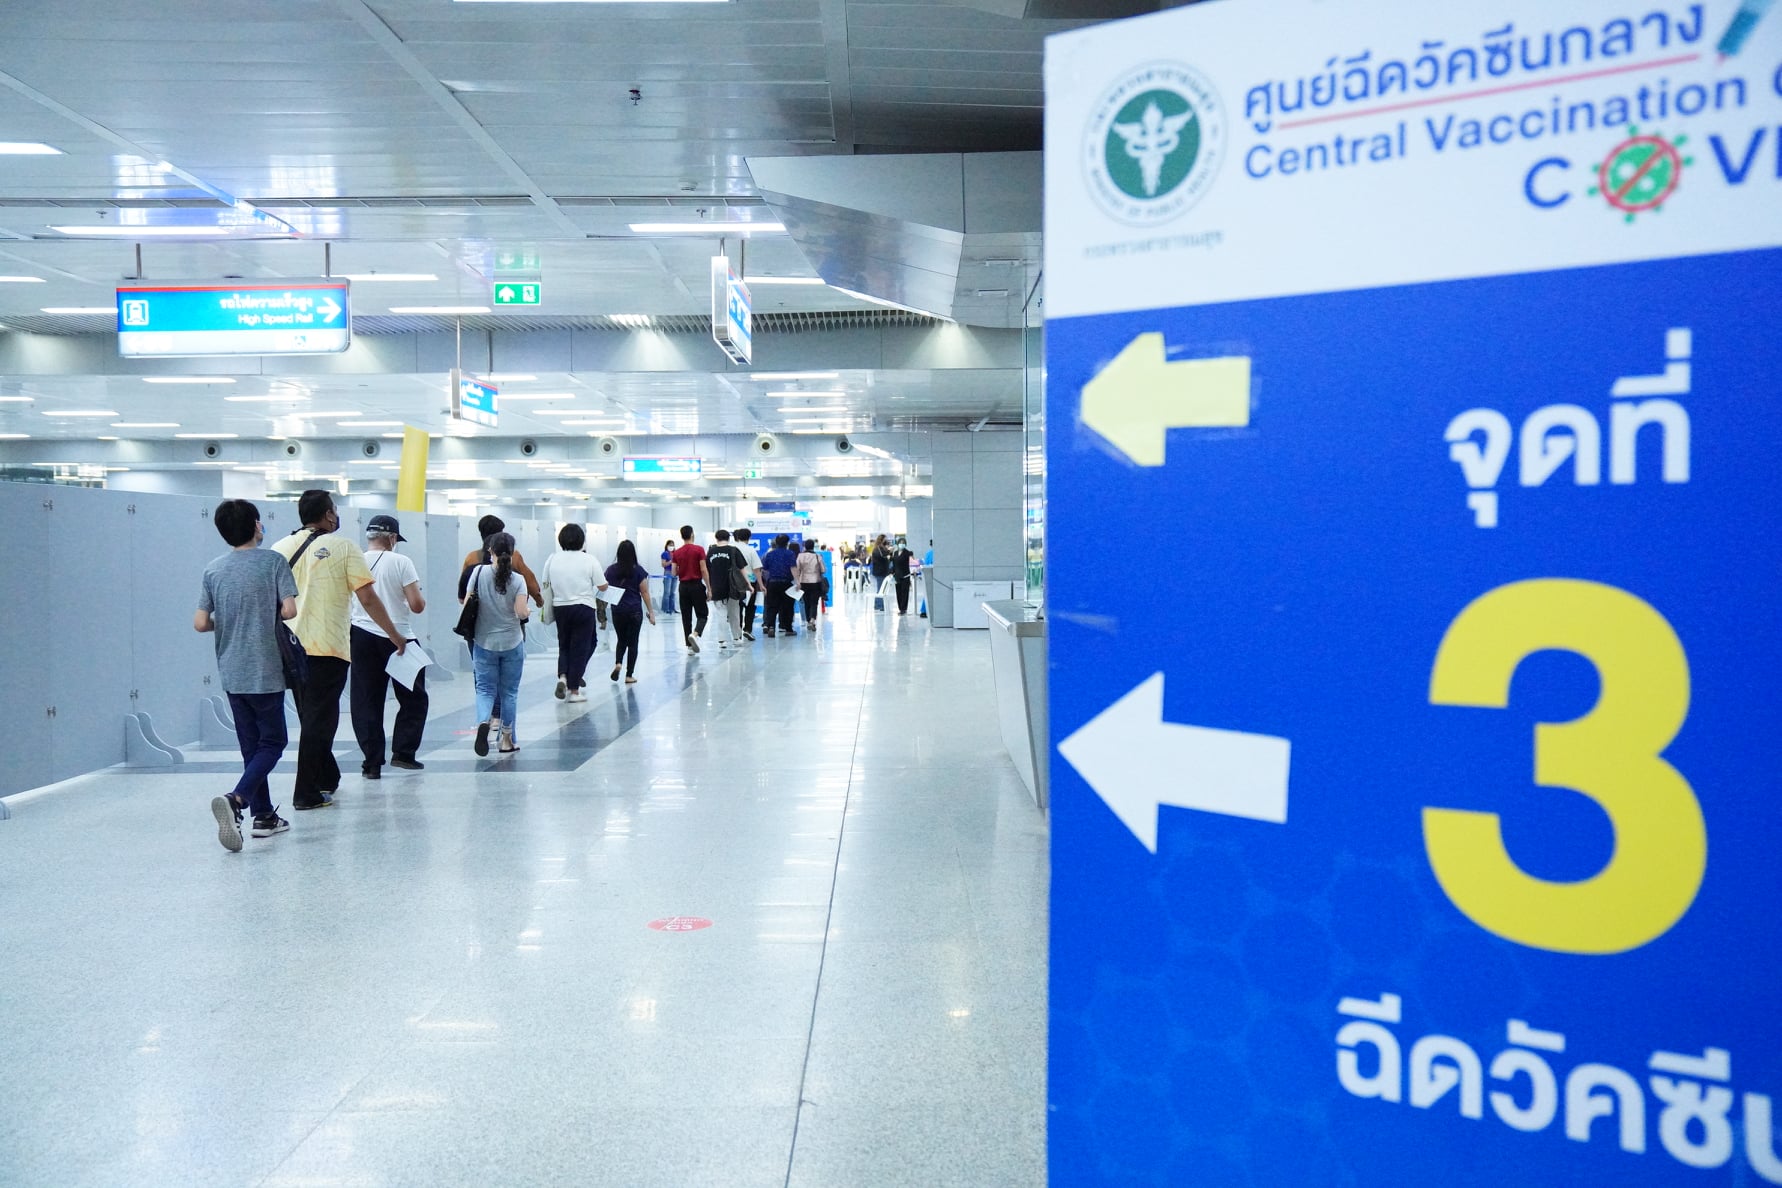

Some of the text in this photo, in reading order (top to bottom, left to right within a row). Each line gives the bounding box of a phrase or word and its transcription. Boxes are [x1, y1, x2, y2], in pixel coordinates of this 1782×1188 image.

[1245, 3, 1704, 133] ศูนย์ฉีดวัคซีนกลาง
[1245, 122, 1407, 178] Central
[1425, 77, 1747, 152] Vaccination
[1444, 327, 1692, 528] จุดที่
[1422, 577, 1708, 954] 3
